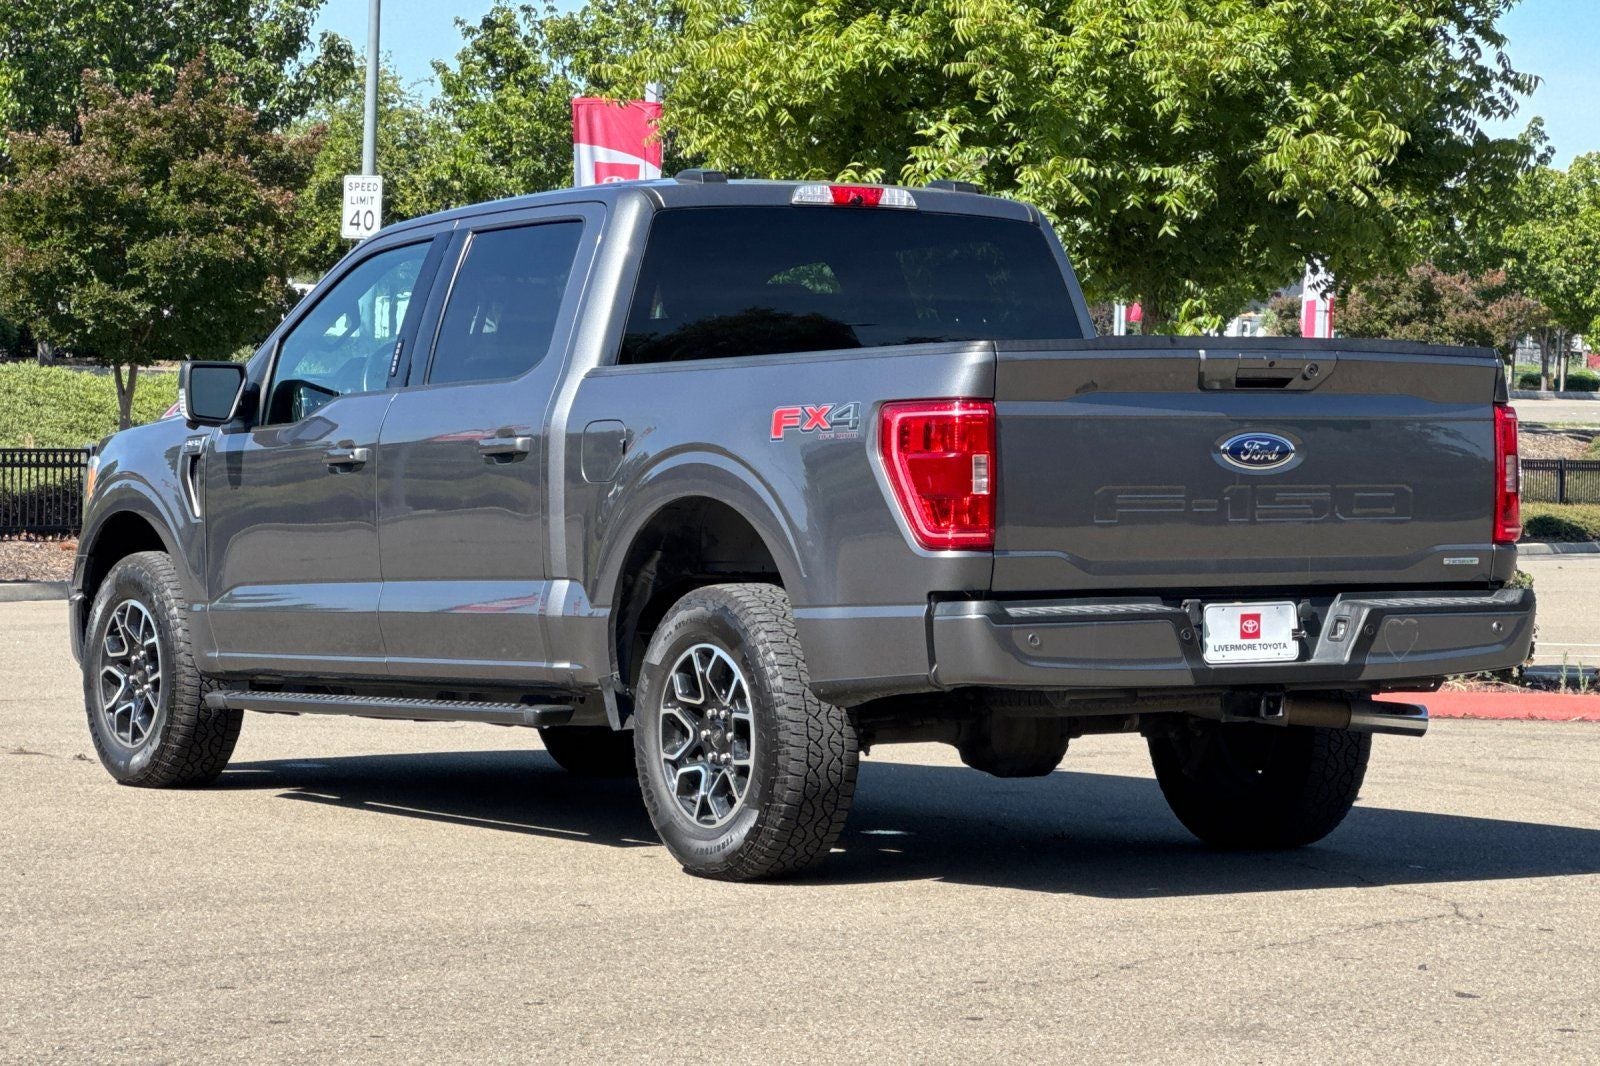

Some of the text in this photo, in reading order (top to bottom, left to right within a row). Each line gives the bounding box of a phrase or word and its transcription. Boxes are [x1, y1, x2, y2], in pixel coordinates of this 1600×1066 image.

[348, 182, 378, 191] SPEED
[350, 196, 374, 205] LIMIT
[349, 209, 374, 231] 40
[770, 401, 861, 442] FX4
[1240, 440, 1280, 461] Ford
[1094, 485, 1413, 523] F-150
[1213, 642, 1288, 652] LIVERMORE TOYOTA
